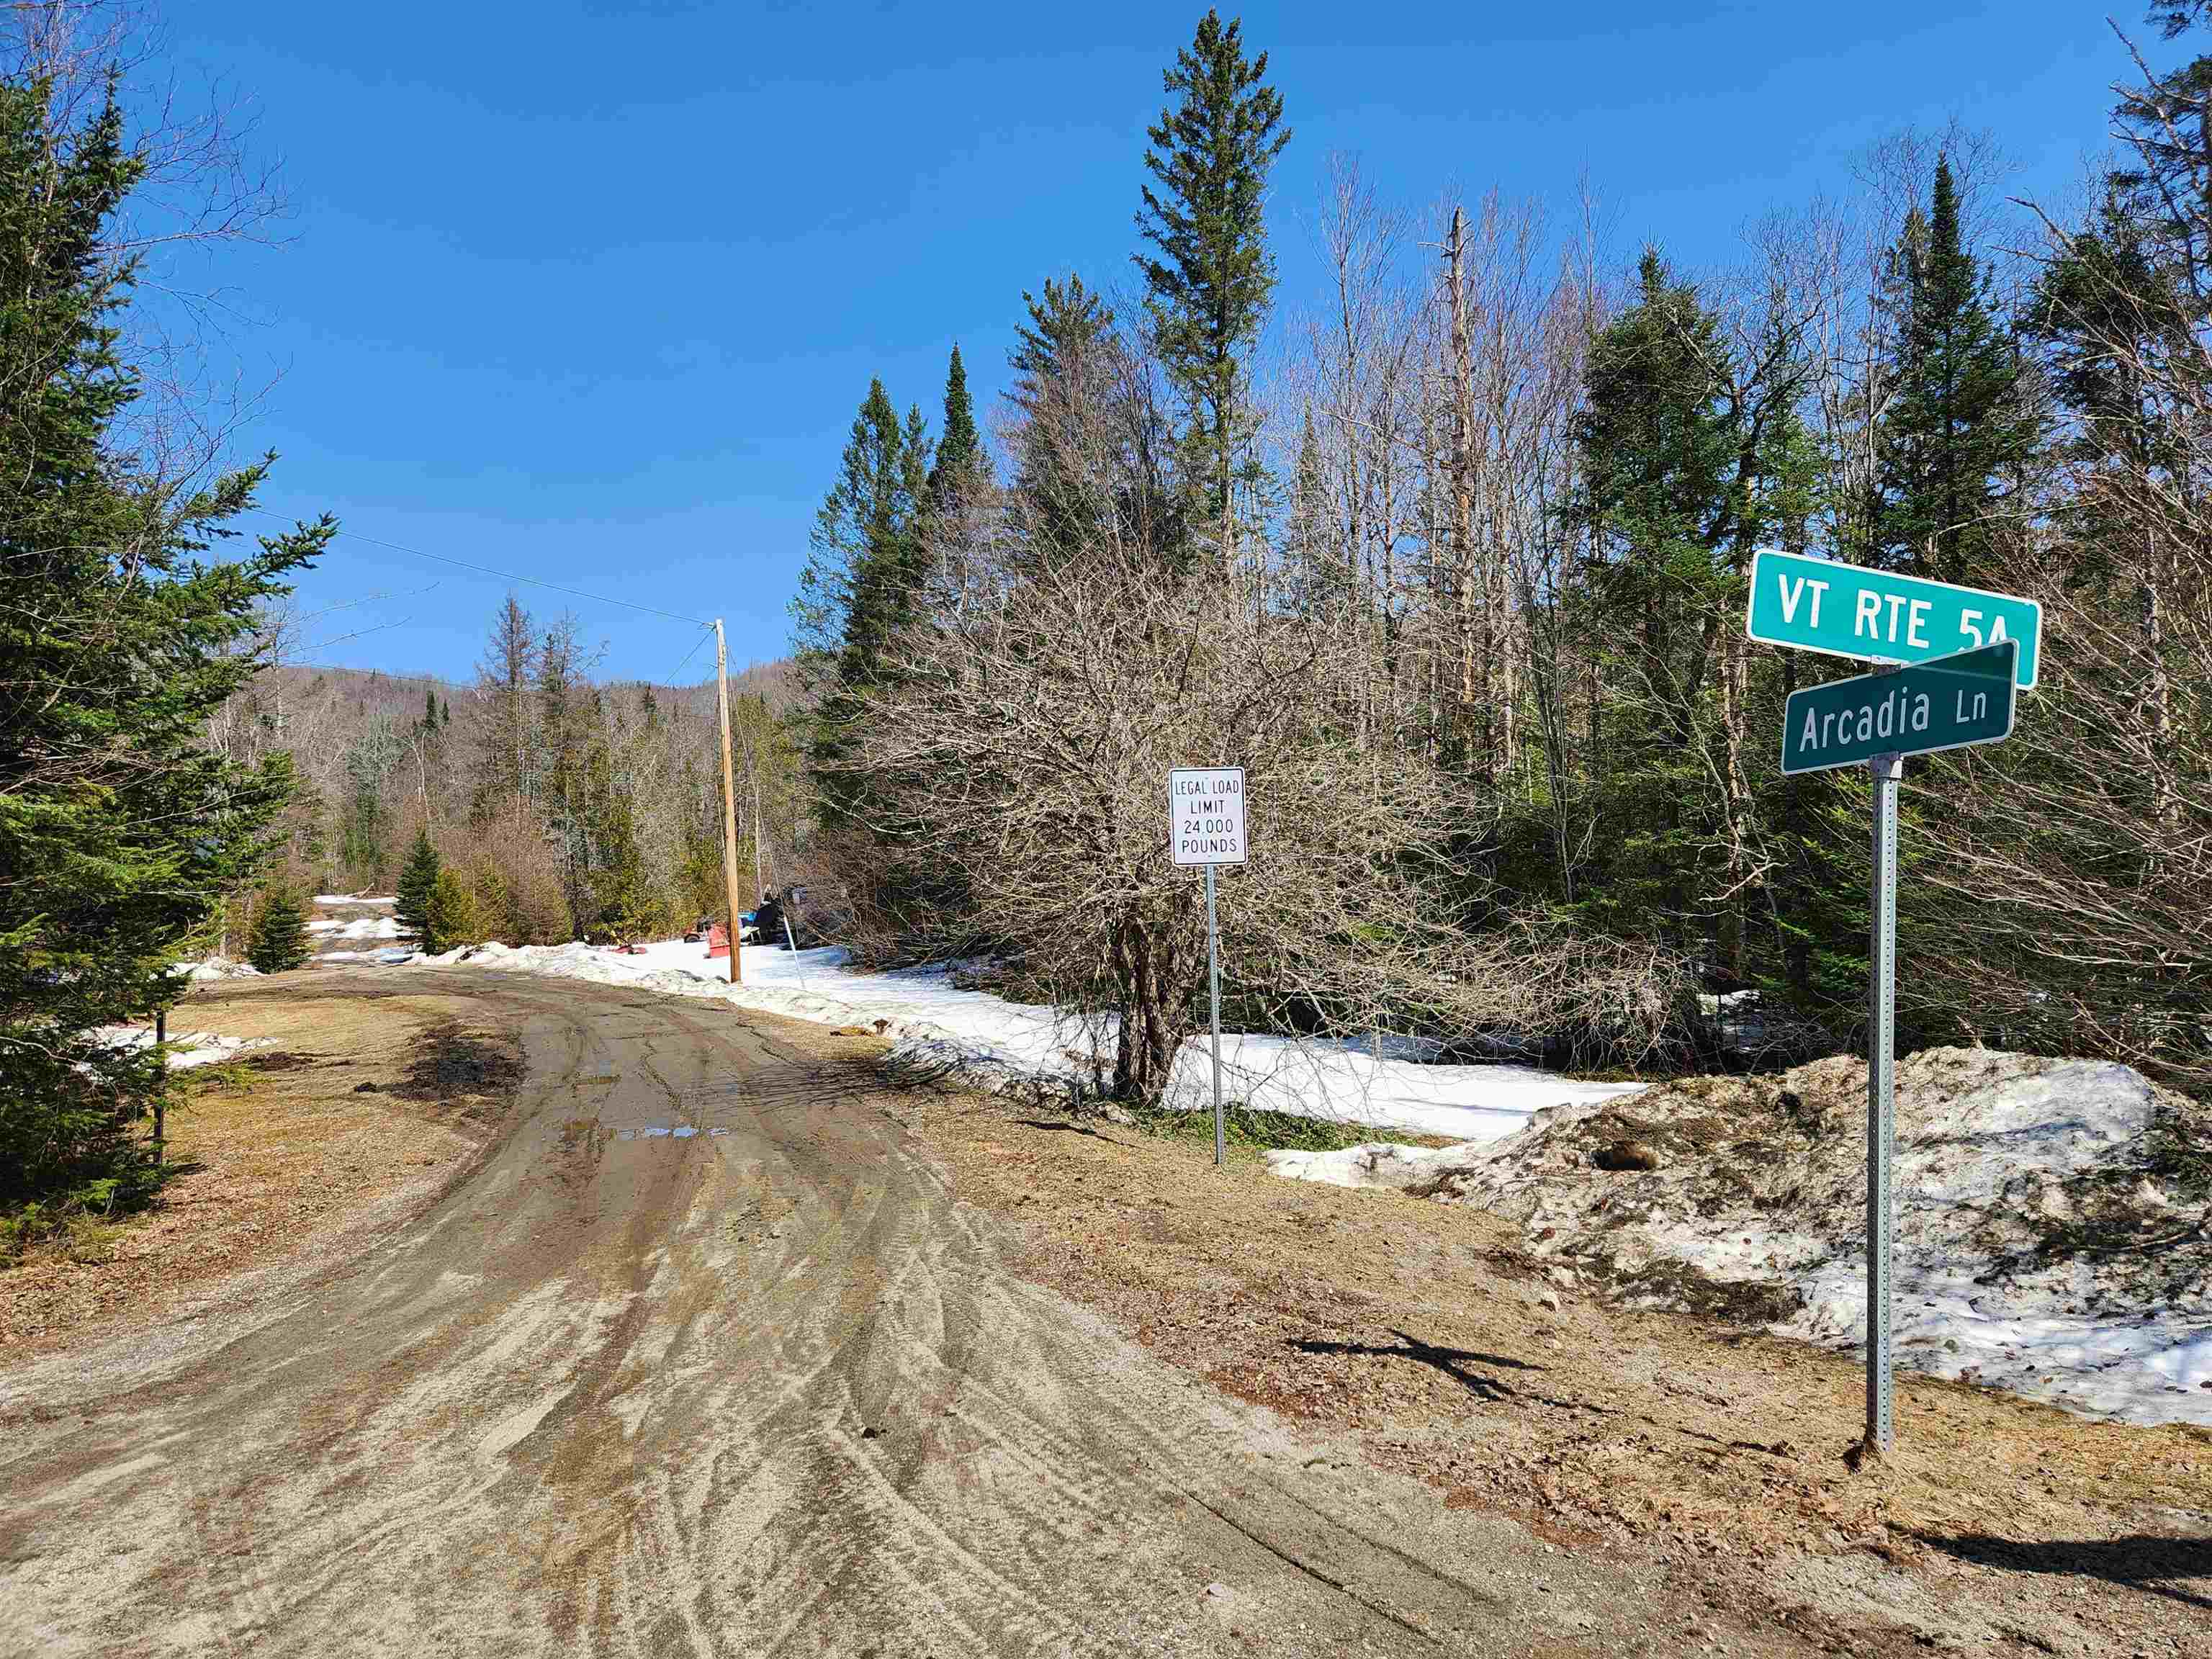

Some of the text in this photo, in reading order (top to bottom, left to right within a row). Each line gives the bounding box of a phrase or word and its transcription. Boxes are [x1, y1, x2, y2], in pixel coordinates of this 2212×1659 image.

[1778, 574, 1830, 629] VT
[1854, 589, 1932, 649] RTE
[1799, 686, 1987, 752] Arcadia Ln
[1175, 780, 1239, 795] LEGAL LOAD
[1191, 800, 1225, 814] LIMIT
[1182, 838, 1237, 853] POUNDS
